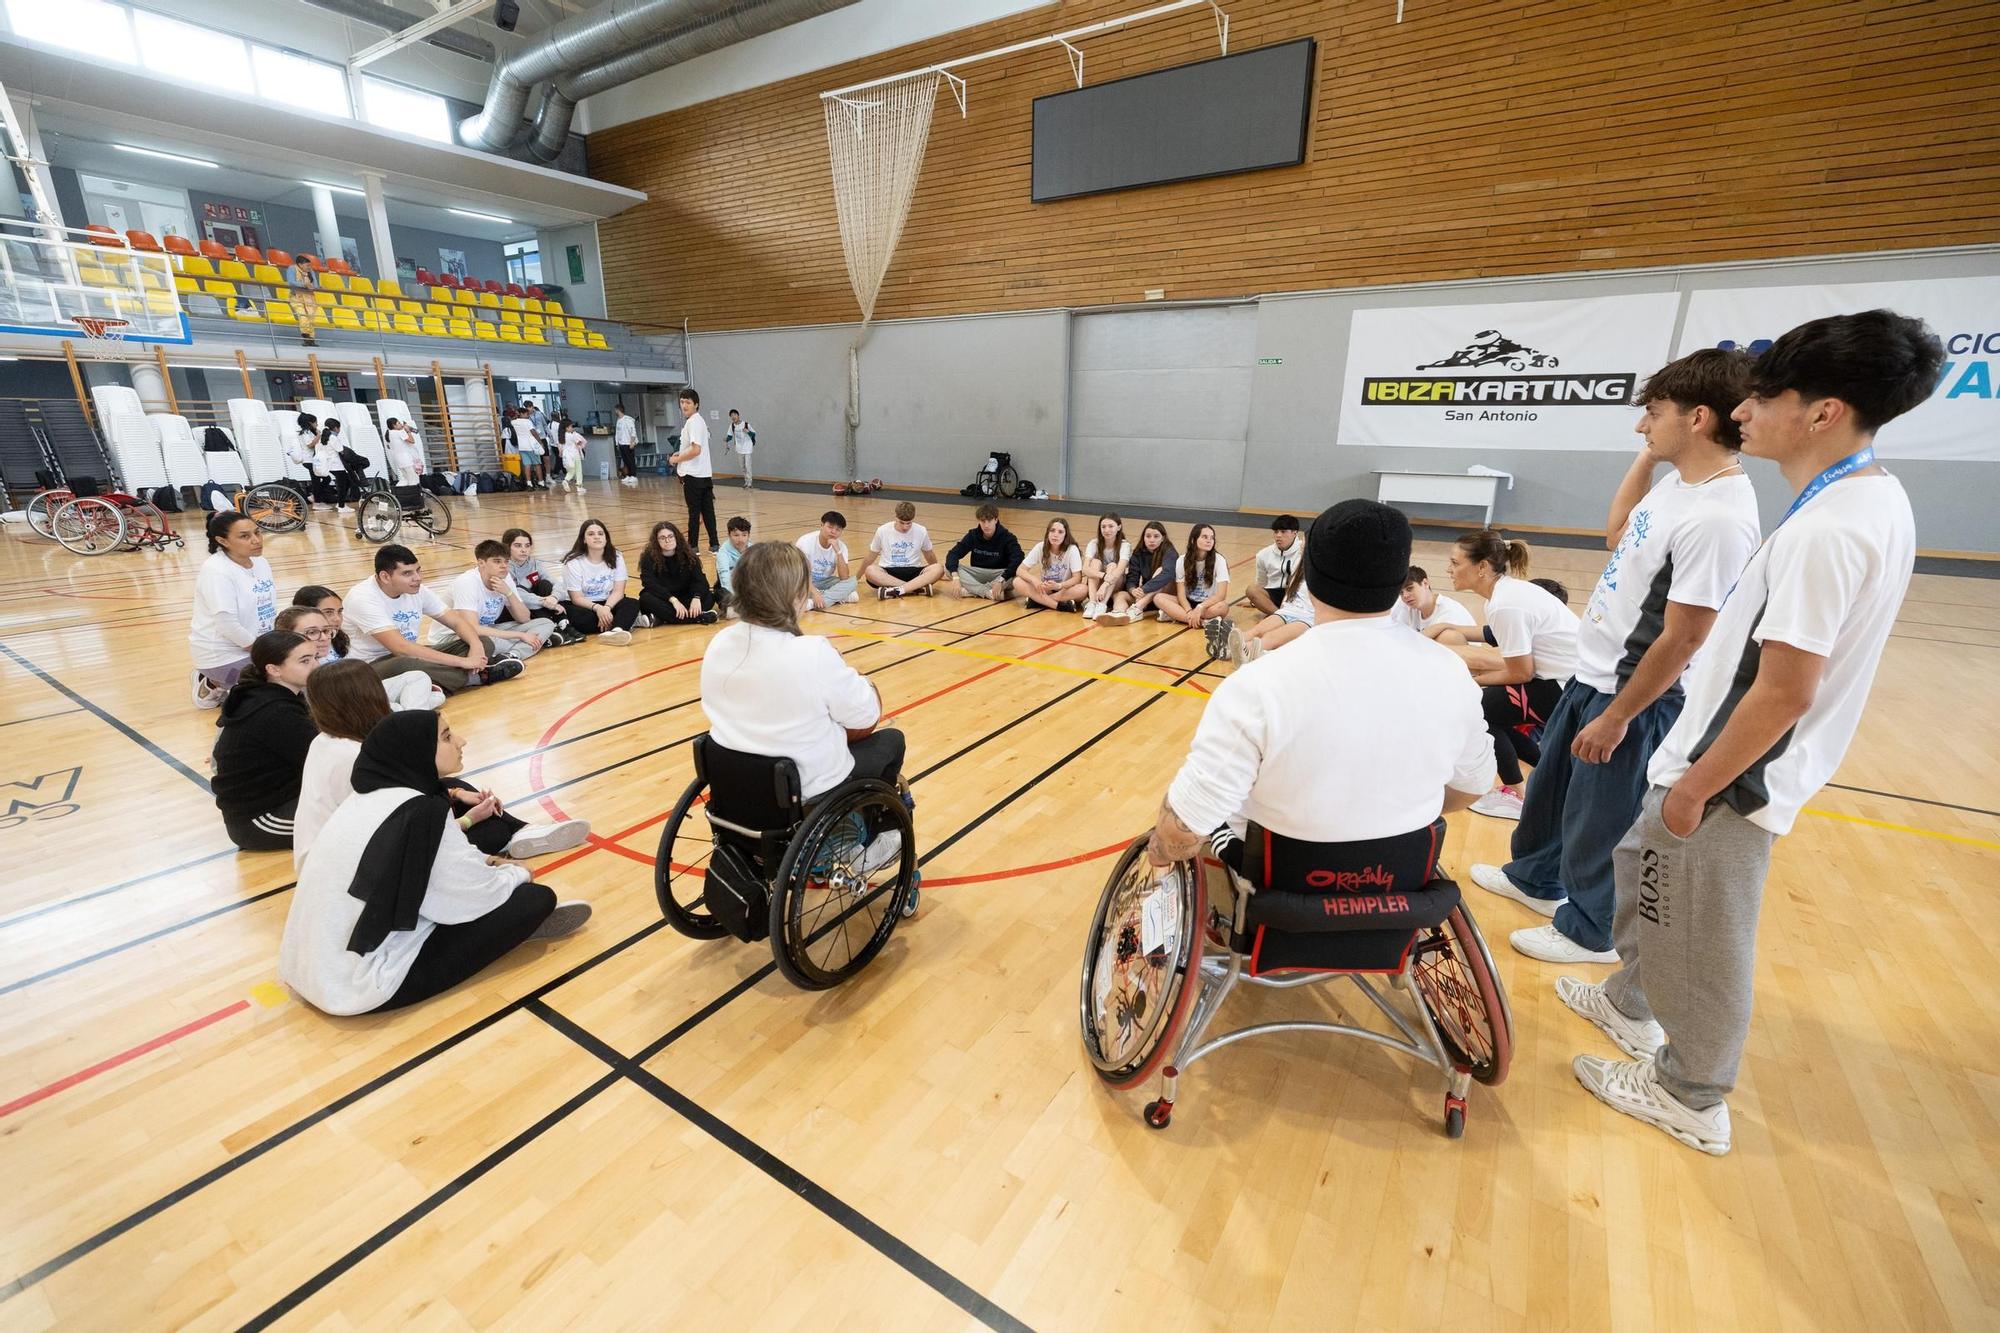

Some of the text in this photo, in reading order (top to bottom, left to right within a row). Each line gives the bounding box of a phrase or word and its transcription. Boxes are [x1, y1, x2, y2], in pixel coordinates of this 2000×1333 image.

[1368, 379, 1626, 400] IBIZAKARTING
[1444, 410, 1538, 422] San Antonio
[1639, 846, 1660, 925] BOSS
[1661, 854, 1671, 927] HUGO BOSS
[1323, 895, 1409, 915] HEMPLER
